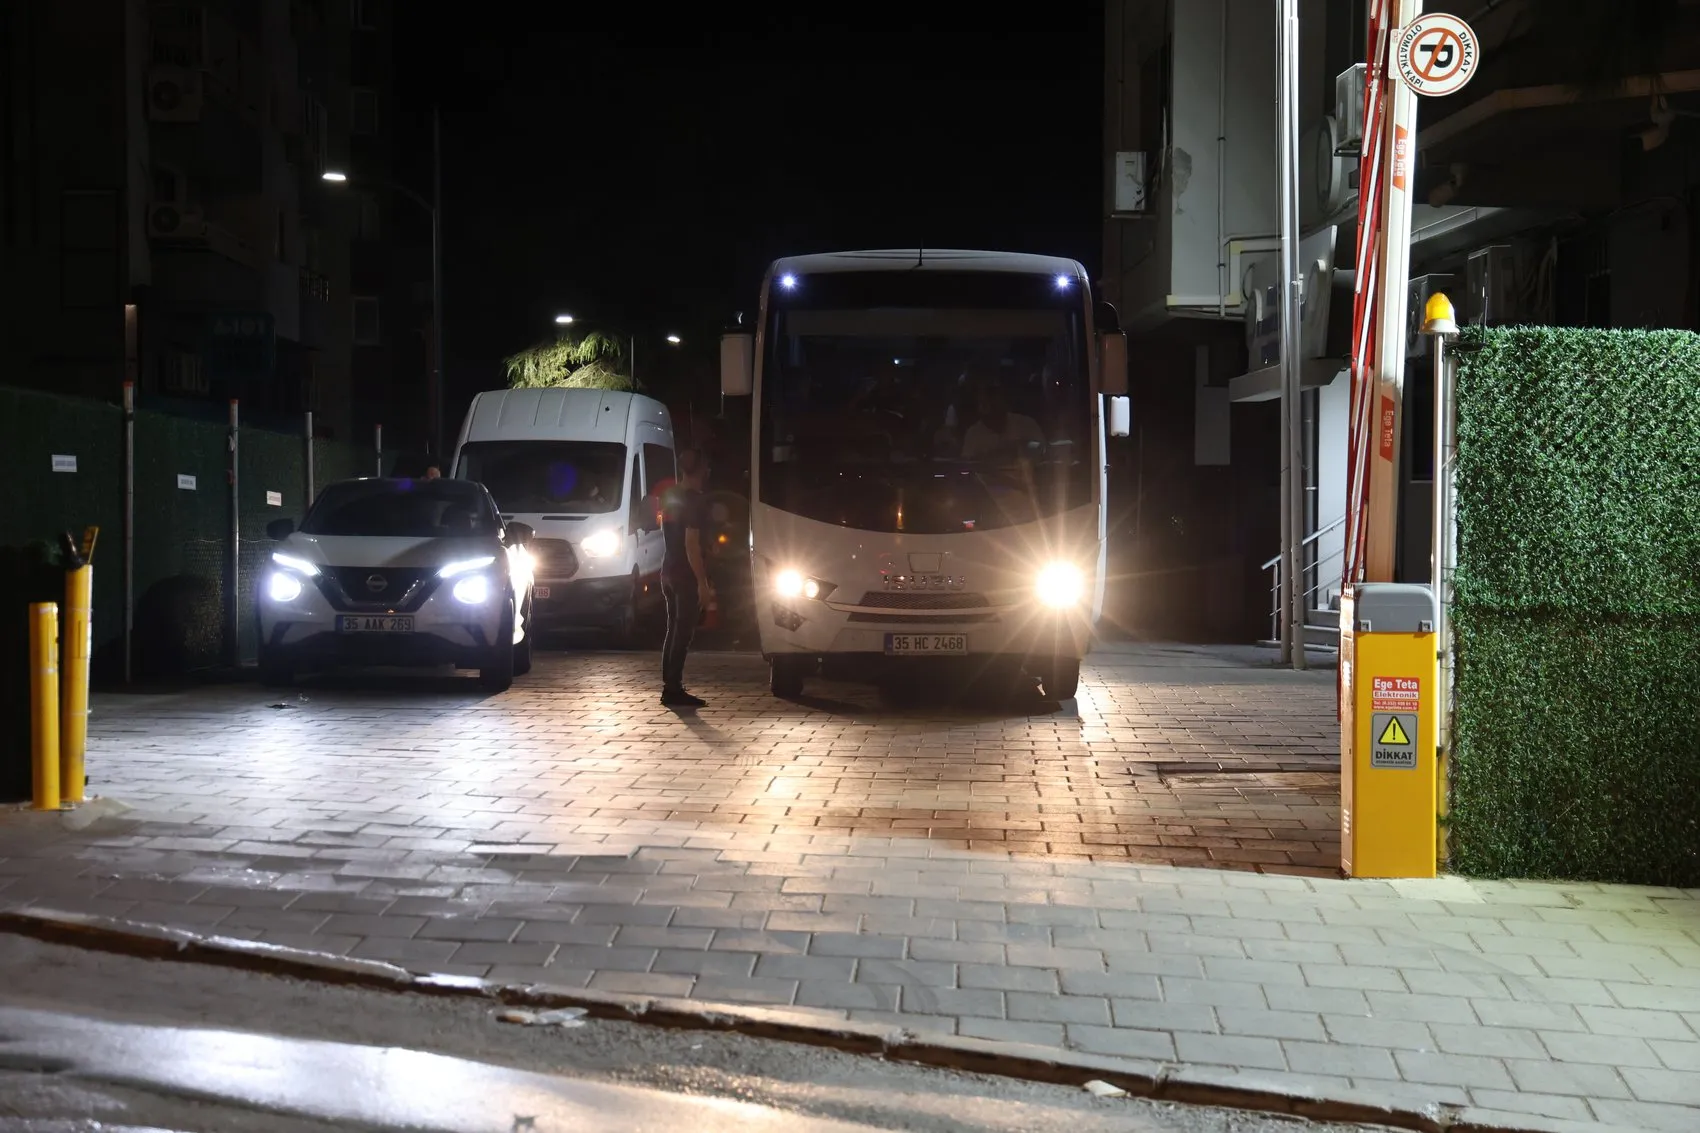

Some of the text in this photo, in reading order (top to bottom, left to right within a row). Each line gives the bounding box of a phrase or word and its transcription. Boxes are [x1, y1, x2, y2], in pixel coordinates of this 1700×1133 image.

[1458, 31, 1473, 75] DİKKAT
[1404, 70, 1424, 88] KAPI
[1383, 410, 1394, 426] Ege
[344, 617, 411, 631] 35 AAK 269
[894, 636, 963, 650] 35 HC 2468
[1374, 678, 1418, 690] Ege Teta
[1375, 748, 1413, 760] DİKKAT
